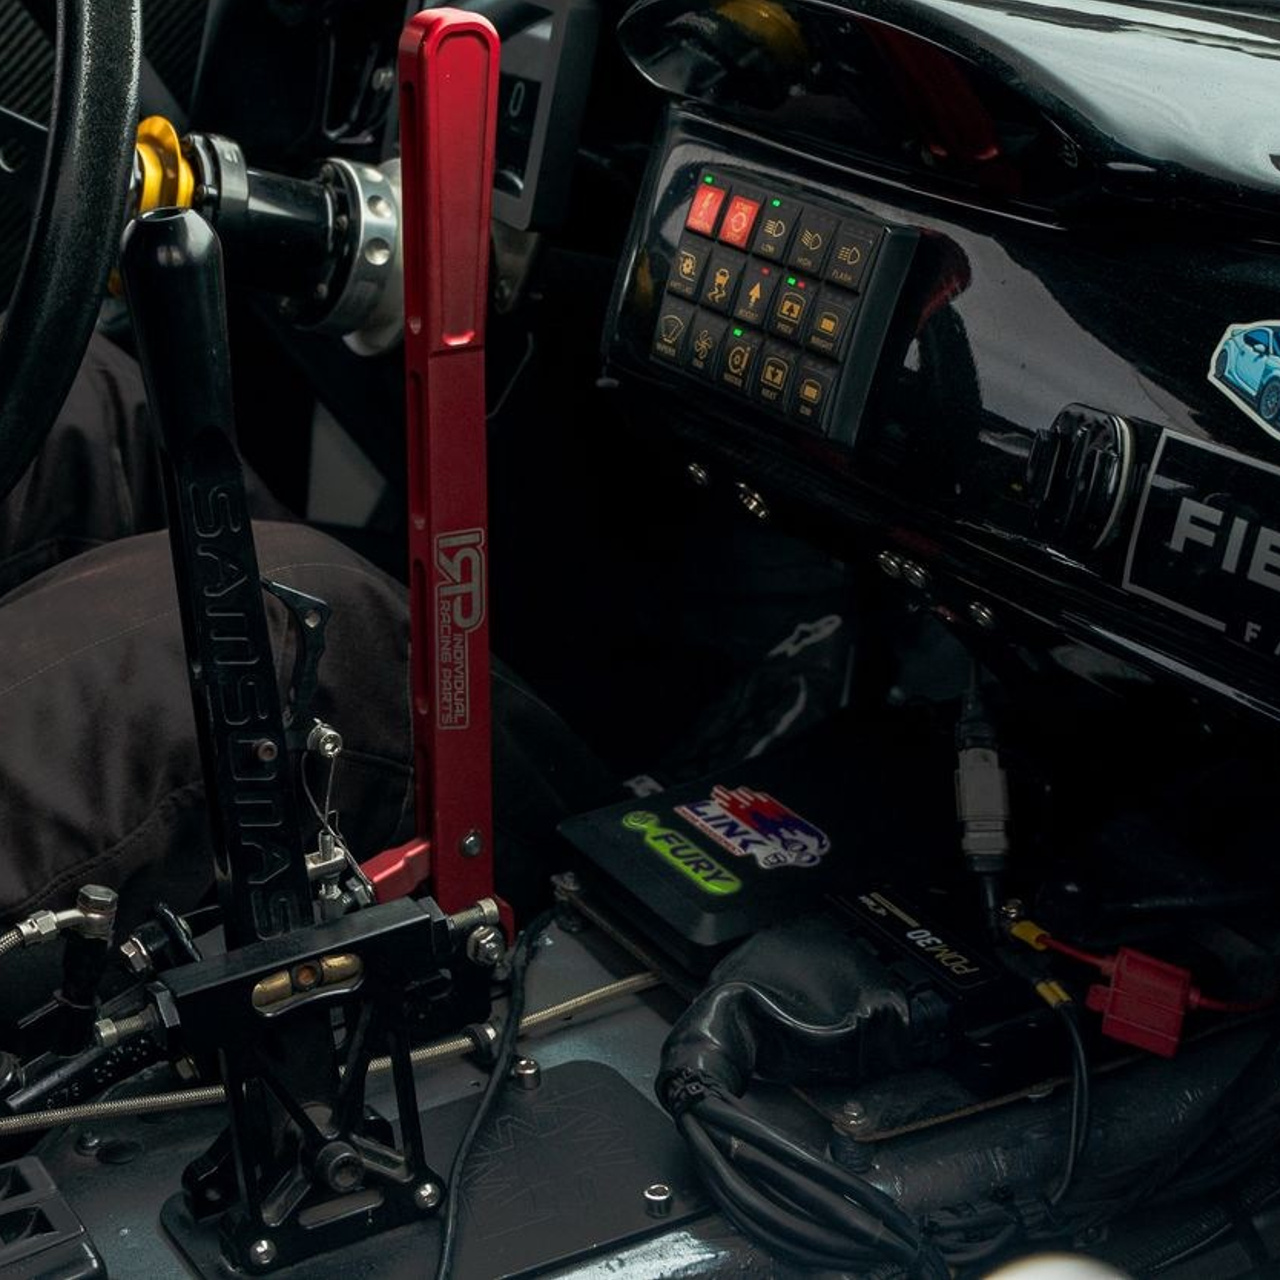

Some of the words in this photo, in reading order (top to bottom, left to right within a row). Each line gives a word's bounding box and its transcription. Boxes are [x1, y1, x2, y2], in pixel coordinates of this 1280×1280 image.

[439, 599, 453, 663] RACING
[440, 667, 454, 725] PARTS
[453, 632, 465, 725] INDIVIDUAL
[651, 831, 735, 884] FURY
[905, 927, 981, 976] PDM30
